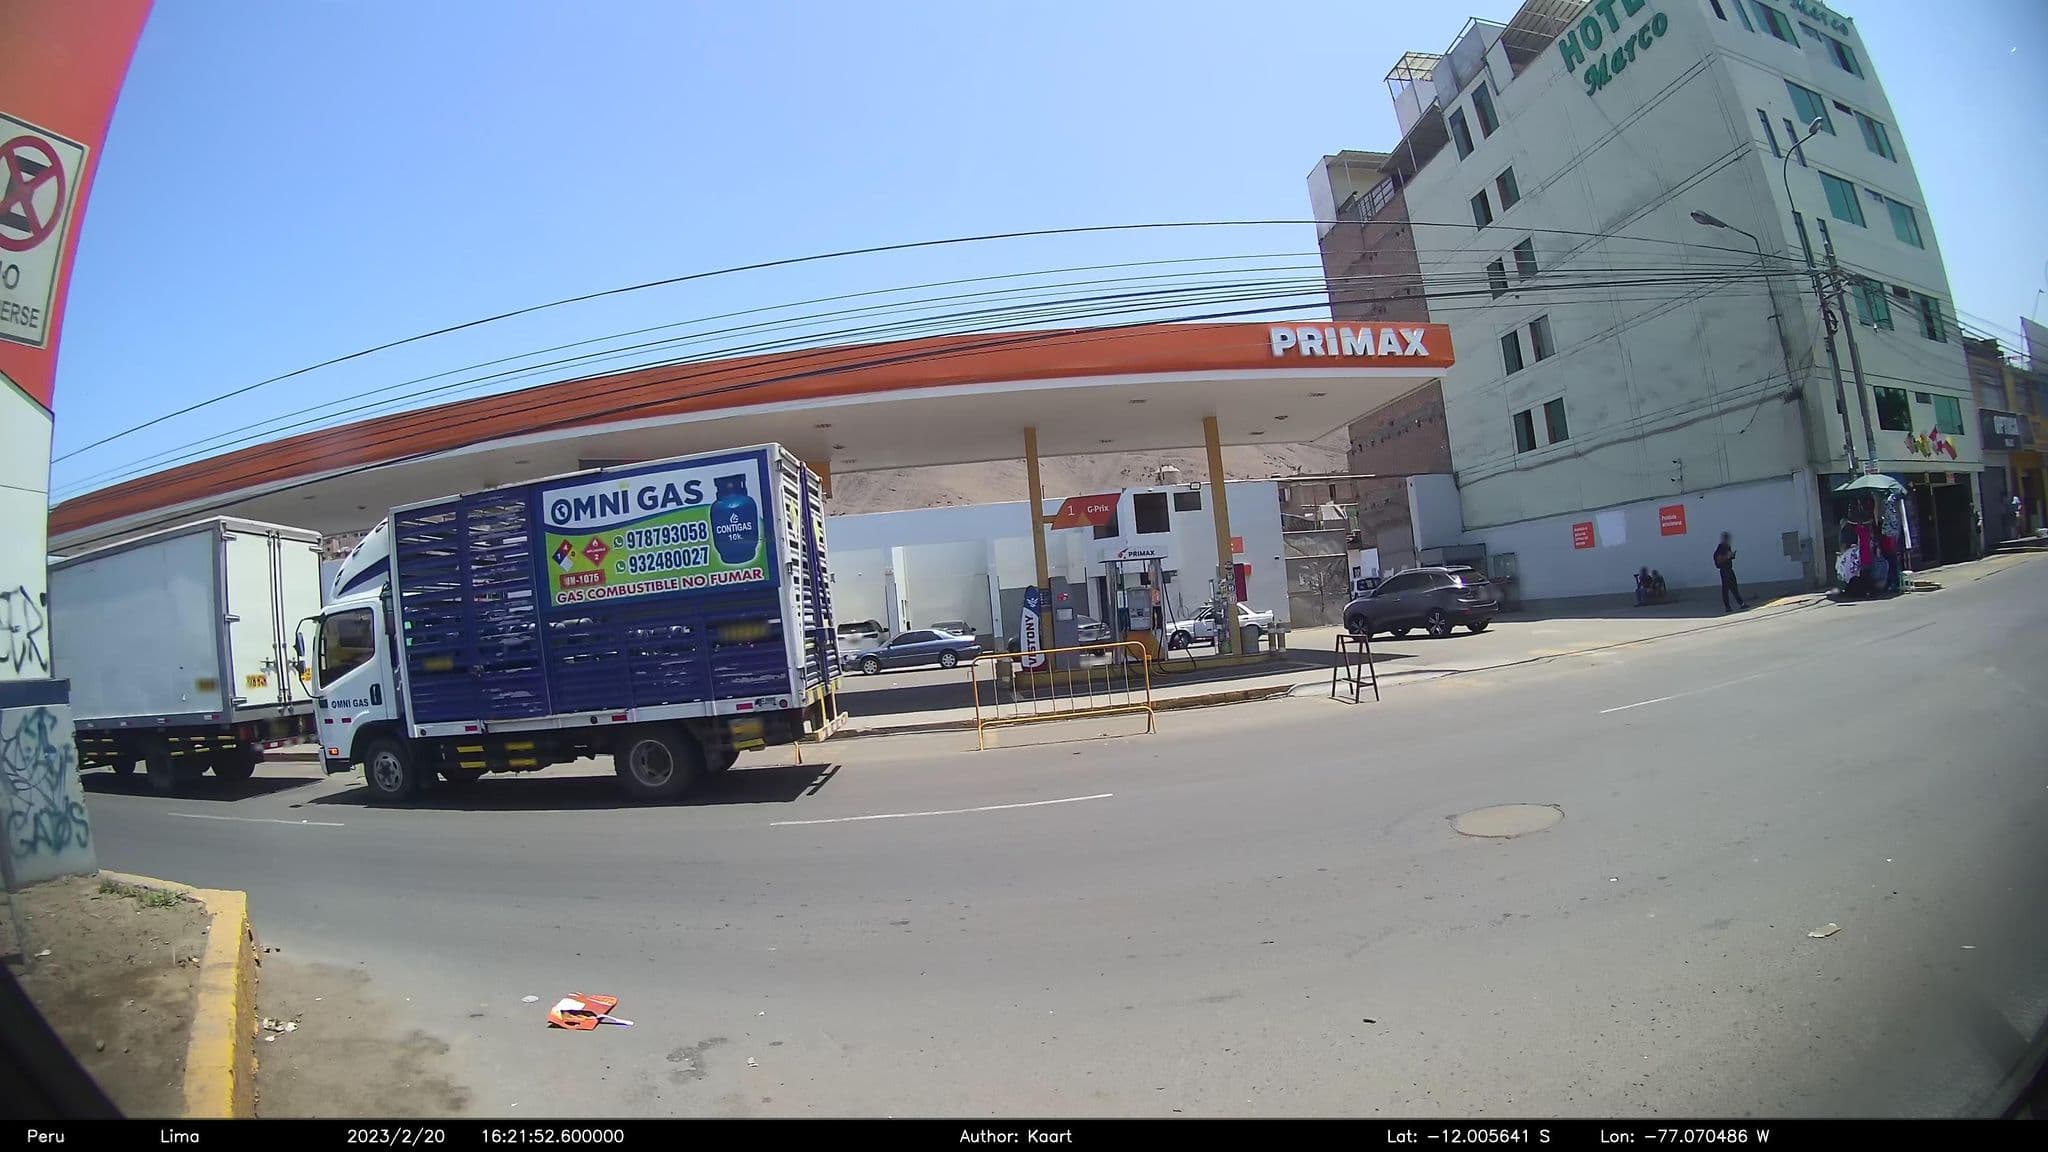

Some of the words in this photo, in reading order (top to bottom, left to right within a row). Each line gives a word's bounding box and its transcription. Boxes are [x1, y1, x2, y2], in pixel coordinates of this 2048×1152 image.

[1584, 12, 1668, 97] Marco
[1270, 326, 1430, 358] PRIMAX
[551, 488, 630, 525] OMNI
[637, 479, 704, 511] GAS
[1067, 505, 1076, 516] 1
[1087, 504, 1110, 513] G-Prix
[627, 522, 708, 549] 978793058
[716, 521, 752, 534] CONTIGAS
[629, 546, 709, 573] 932480027
[1128, 550, 1155, 558] PRIMAX
[557, 590, 584, 604] GAS
[587, 578, 678, 600] COMBUSTIBLE
[682, 575, 706, 589] NO
[711, 569, 763, 585] FUMAR
[331, 699, 351, 709] OMNI
[353, 698, 369, 708] GAS
